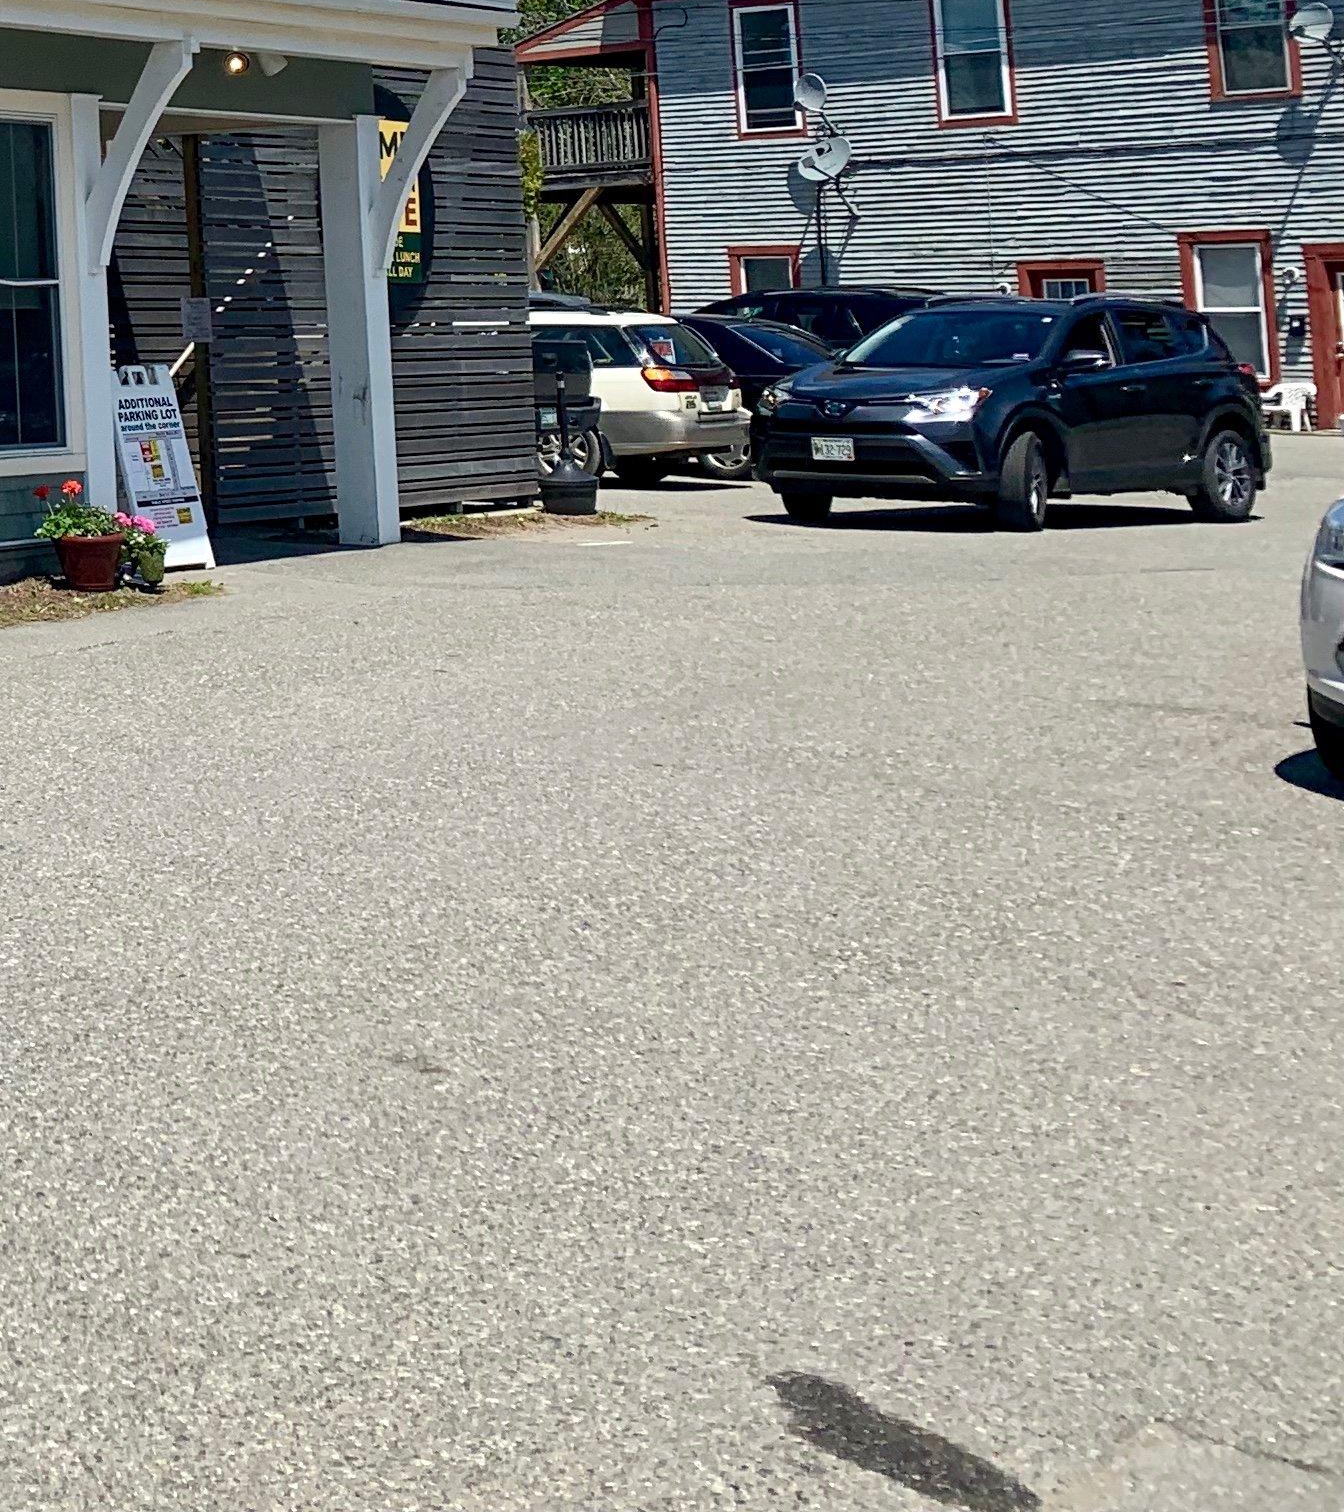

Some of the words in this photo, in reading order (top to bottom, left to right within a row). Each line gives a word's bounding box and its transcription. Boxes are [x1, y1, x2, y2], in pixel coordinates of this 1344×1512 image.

[395, 251, 421, 263] LUNCH
[398, 265, 413, 277] DAY
[118, 397, 173, 410] ADDITIONAL
[118, 410, 158, 422] PARKING
[160, 409, 177, 419] LOT
[121, 423, 144, 431] around
[145, 422, 156, 430] the
